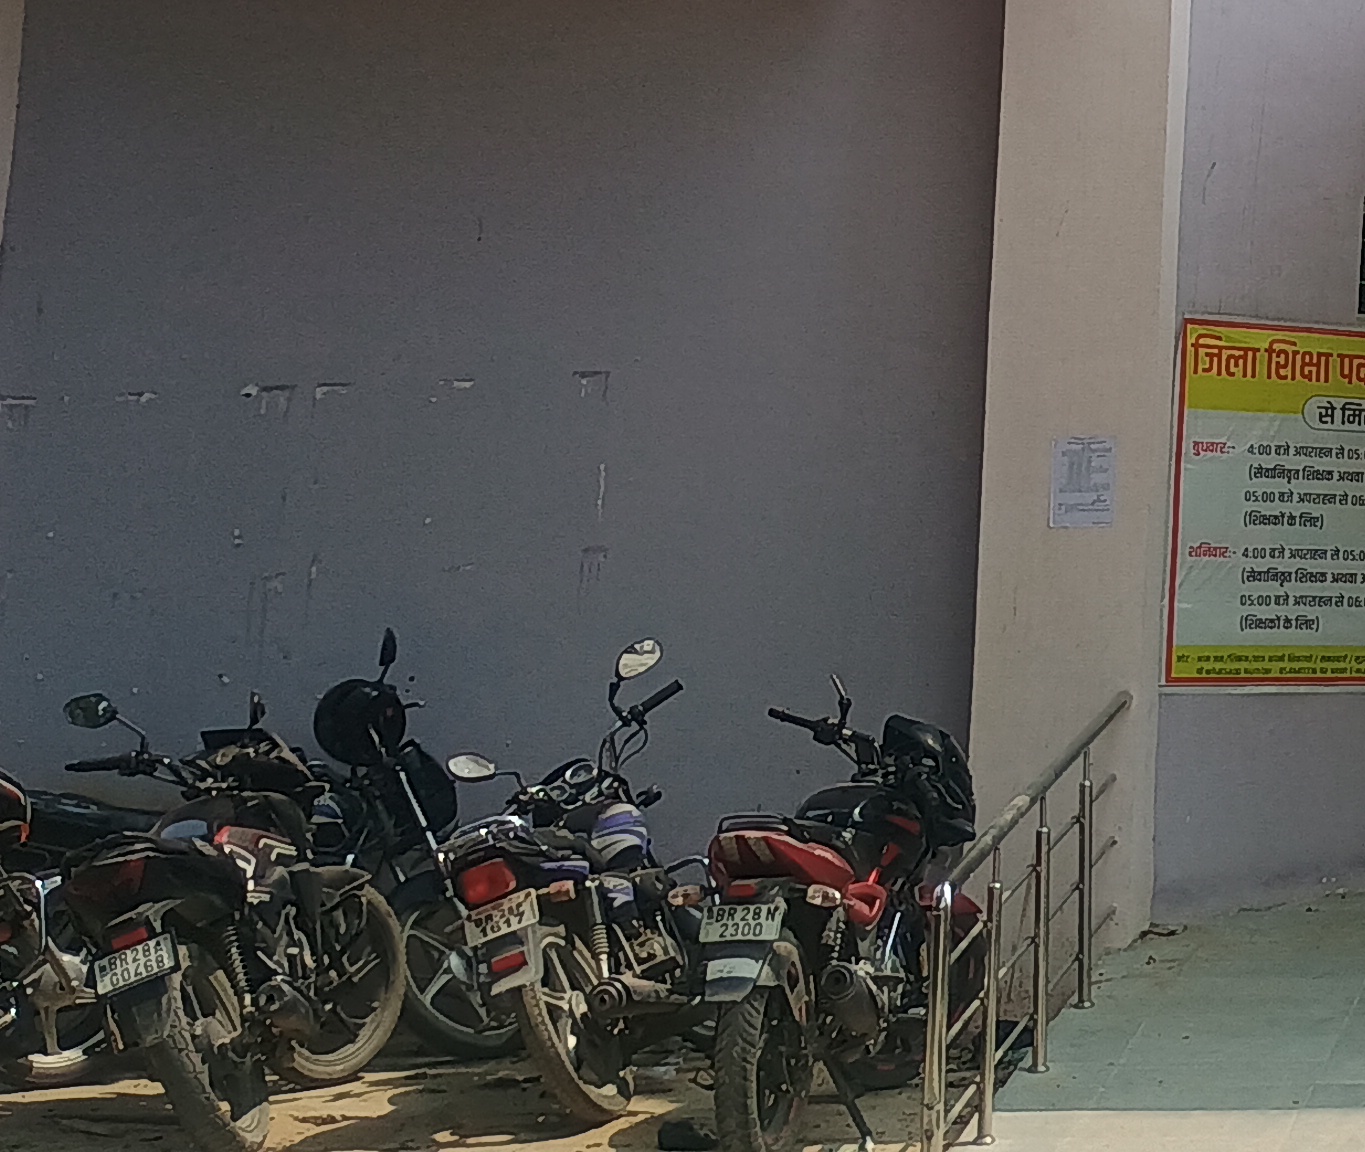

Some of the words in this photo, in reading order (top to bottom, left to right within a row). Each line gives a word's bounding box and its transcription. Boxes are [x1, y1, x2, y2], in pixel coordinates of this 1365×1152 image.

[1191, 333, 1260, 379] जिला
[1265, 339, 1333, 383] शिक्षा
[1317, 401, 1337, 424] से
[1247, 444, 1271, 456] 4:00
[1335, 445, 1344, 459] से
[1302, 466, 1335, 481] शिक्षक
[1337, 471, 1364, 483] अथवा
[1339, 491, 1348, 505] से
[1287, 512, 1297, 526] के
[1242, 547, 1266, 559] 4:00
[1330, 546, 1340, 560] से
[1294, 568, 1327, 583] शिक्षक
[1330, 572, 1357, 584] अथवा
[1334, 593, 1344, 607] से
[1282, 615, 1292, 630] के
[719, 922, 763, 938] 2300
